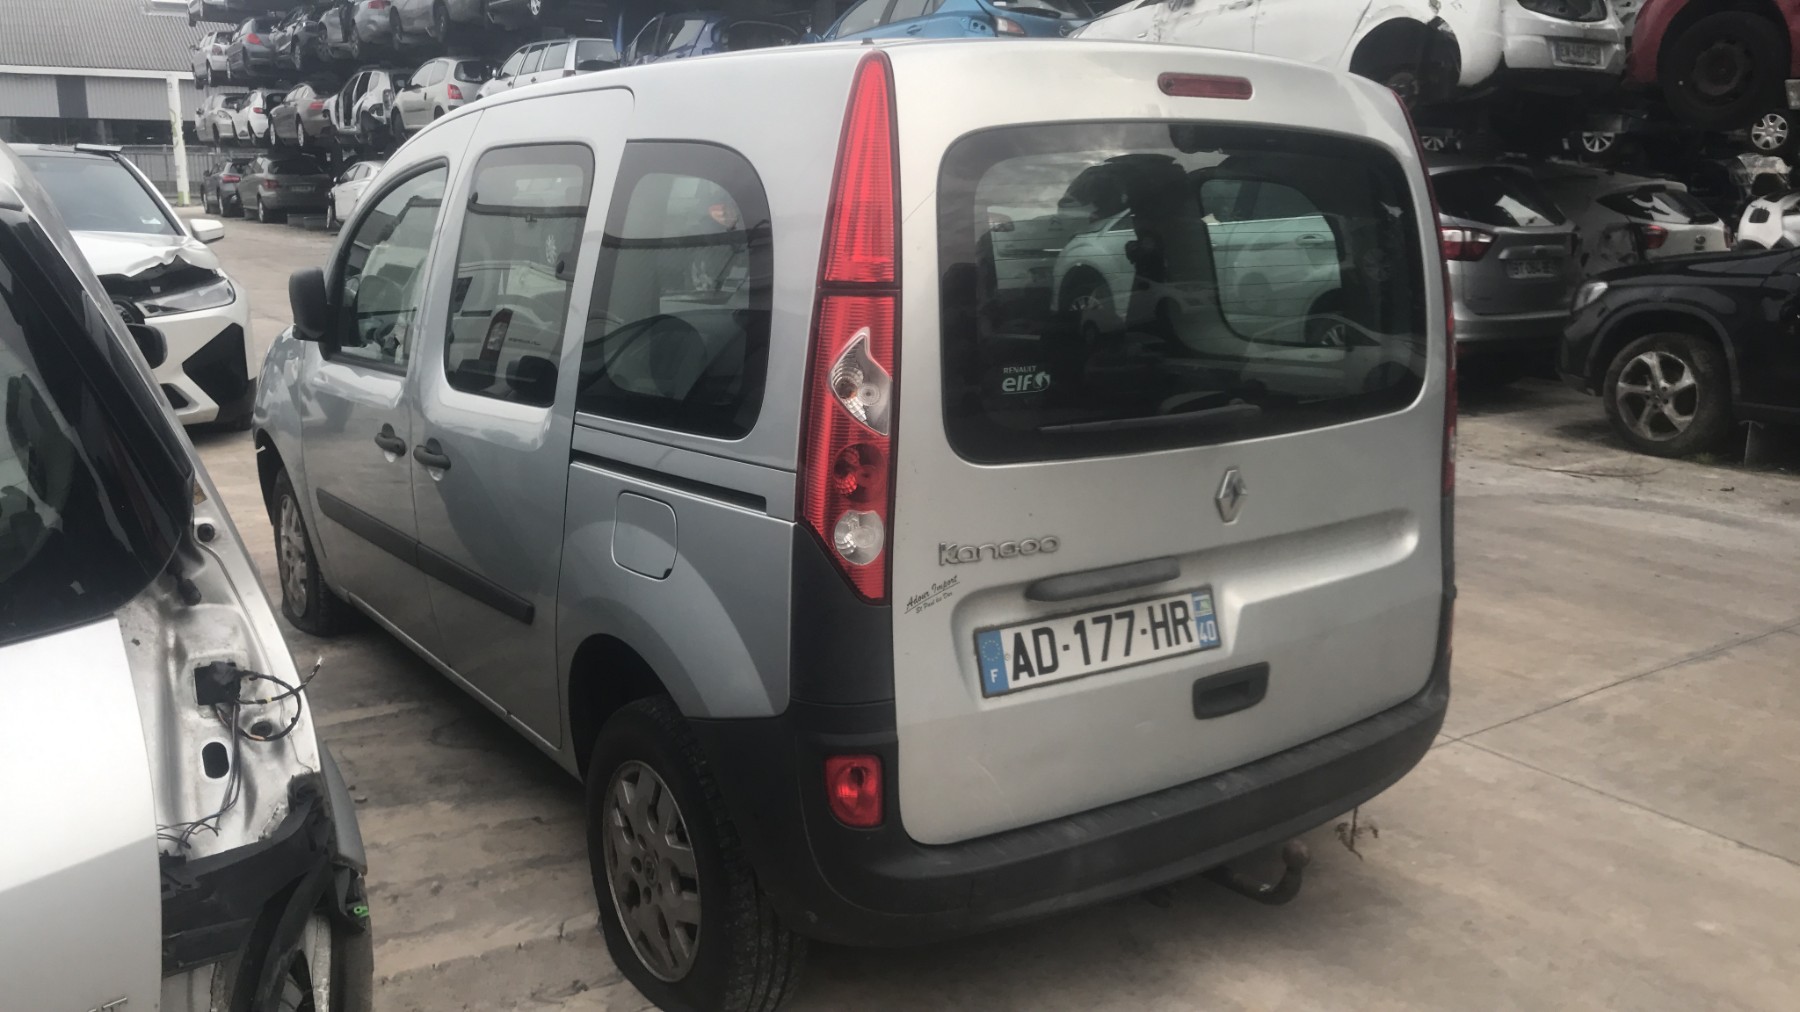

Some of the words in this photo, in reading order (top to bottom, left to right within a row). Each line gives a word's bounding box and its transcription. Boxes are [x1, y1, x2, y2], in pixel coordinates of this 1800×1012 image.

[1001, 374, 1033, 392] elf
[1003, 365, 1037, 374] RENAULT
[938, 534, 1061, 566] Kangoo
[906, 591, 930, 610] Adour
[931, 574, 958, 591] Import
[990, 668, 999, 684] F
[1011, 600, 1194, 682] AD-177-HR
[1199, 620, 1217, 643] 40
